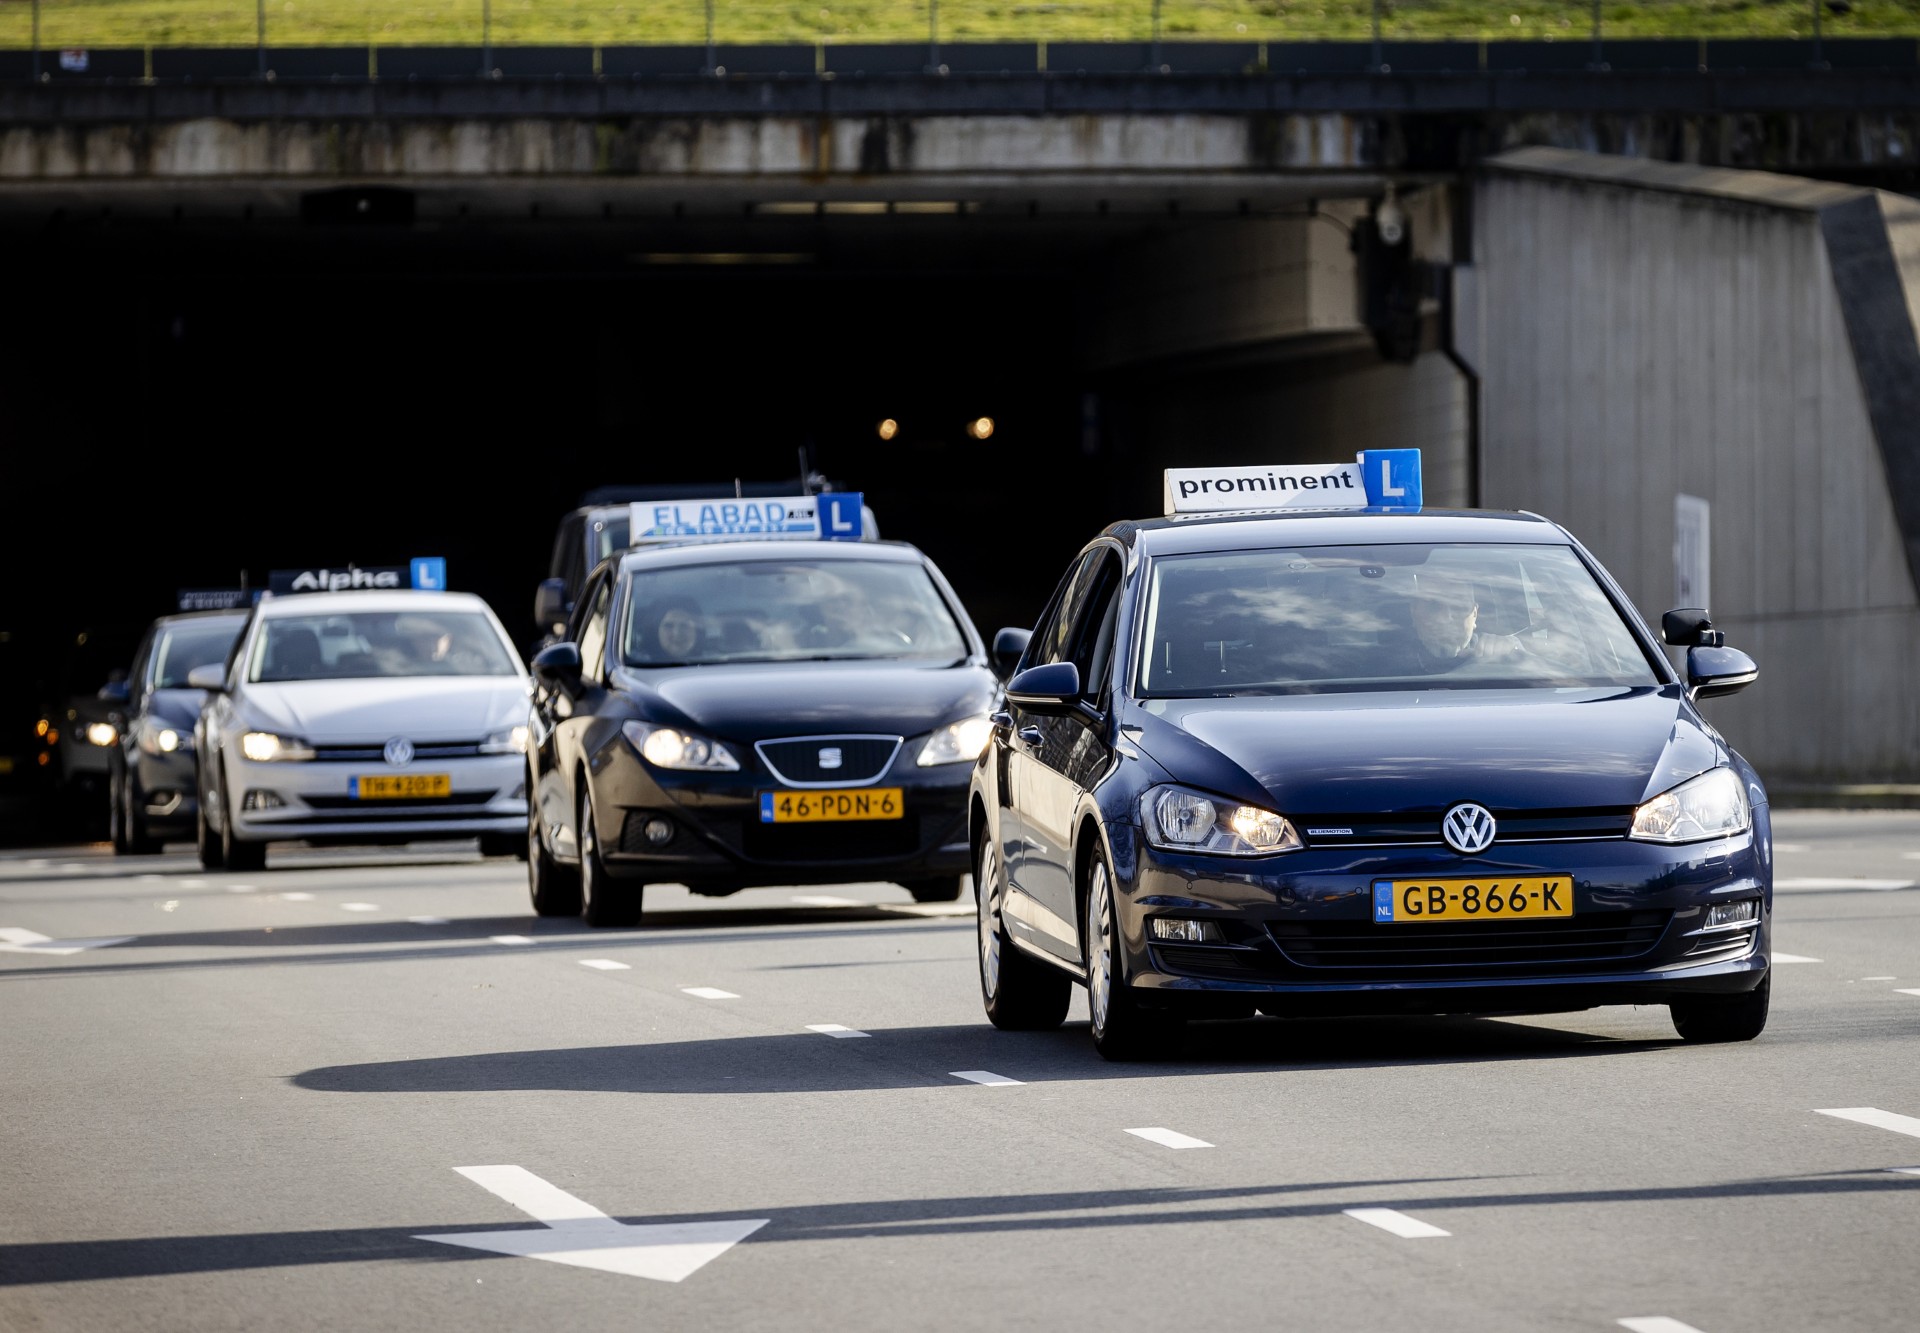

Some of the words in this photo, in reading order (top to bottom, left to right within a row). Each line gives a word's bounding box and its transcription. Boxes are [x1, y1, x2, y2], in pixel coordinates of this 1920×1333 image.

[1178, 470, 1354, 498] prominent
[1381, 459, 1405, 497] L
[654, 505, 690, 526] EL
[699, 502, 786, 526] ABAD
[831, 500, 853, 532] L
[291, 568, 399, 592] Alpha
[418, 562, 437, 587] L
[779, 793, 895, 817] 46-PDN-6
[1402, 881, 1563, 916] GB-866-K
[1377, 906, 1392, 917] NL
